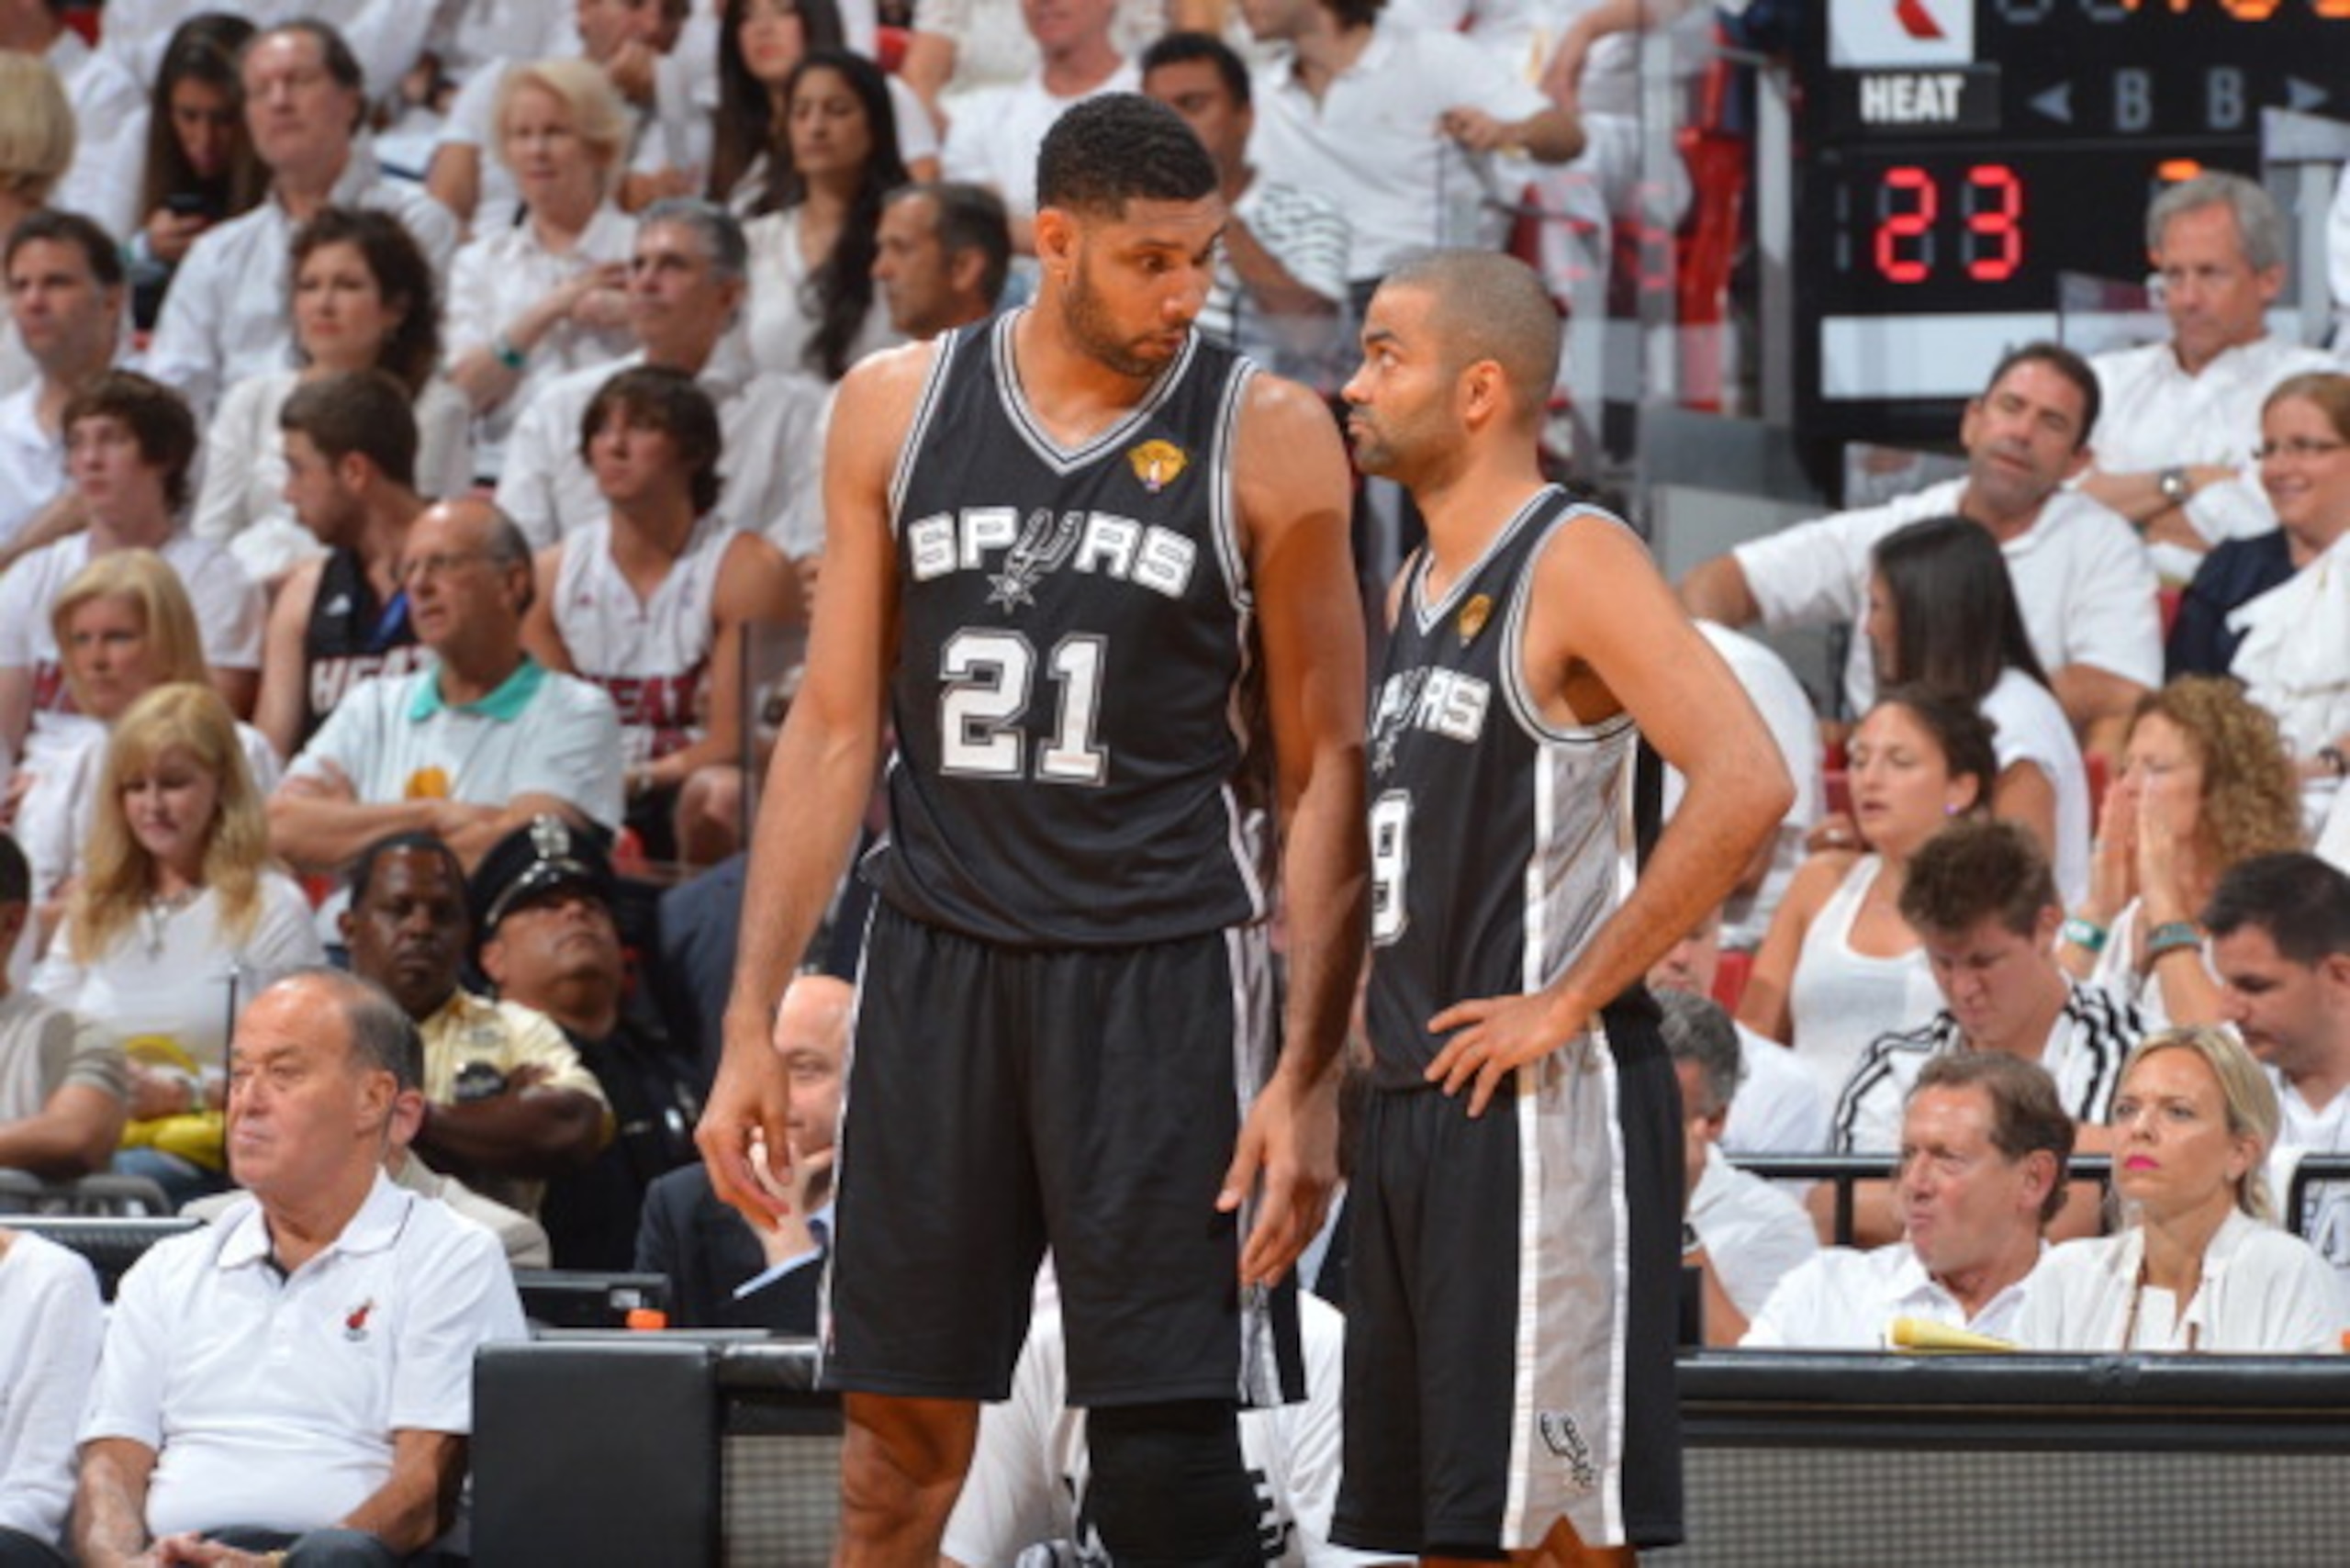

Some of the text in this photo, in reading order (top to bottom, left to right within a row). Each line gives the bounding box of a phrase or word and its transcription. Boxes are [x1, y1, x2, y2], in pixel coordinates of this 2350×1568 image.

[1860, 74, 1964, 122] HEAT
[2116, 68, 2243, 130] B B
[1874, 165, 2022, 283] 23
[907, 506, 1197, 600] SPURS
[939, 626, 1109, 787] 21
[1369, 790, 1414, 946] 9
